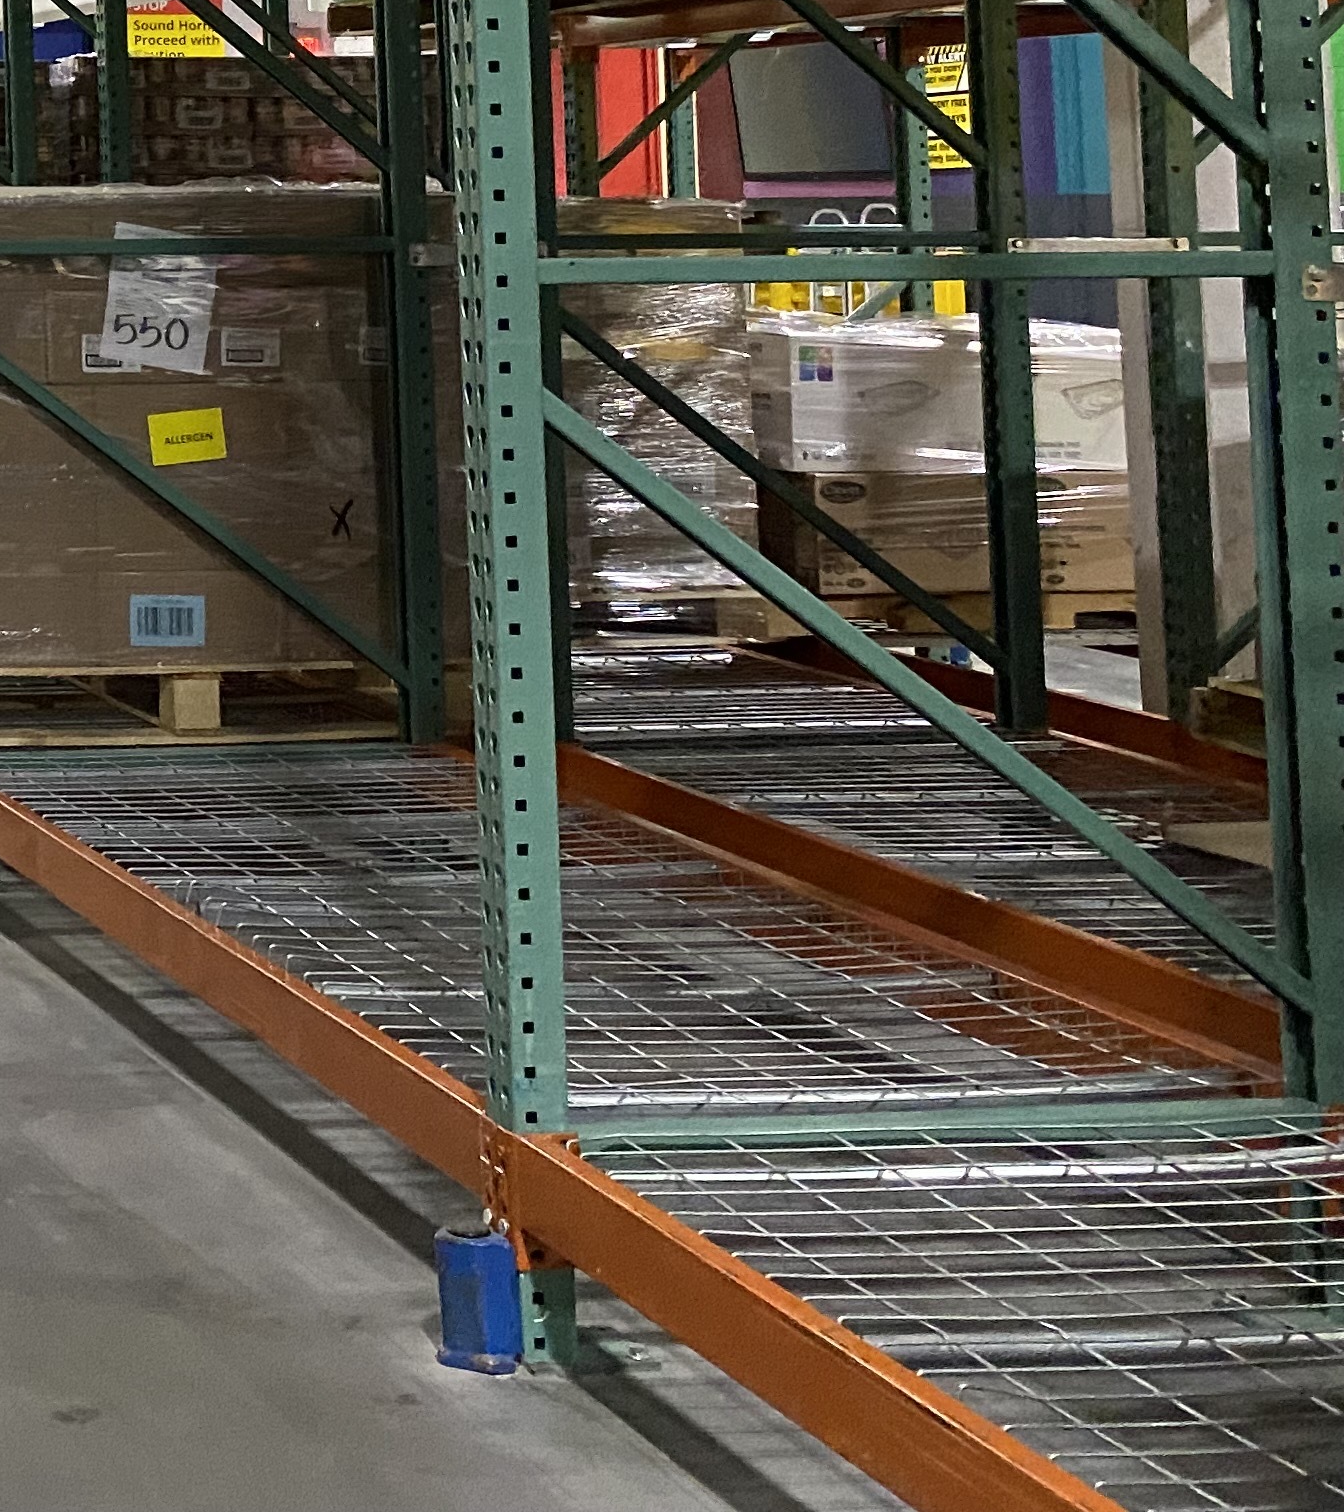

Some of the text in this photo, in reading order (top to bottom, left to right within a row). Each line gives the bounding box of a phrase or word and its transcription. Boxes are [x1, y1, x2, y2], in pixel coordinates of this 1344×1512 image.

[133, 20, 172, 31] Sound
[134, 34, 221, 46] Proceed with
[112, 313, 190, 351] 550
[163, 431, 215, 447] ALLERGEN
